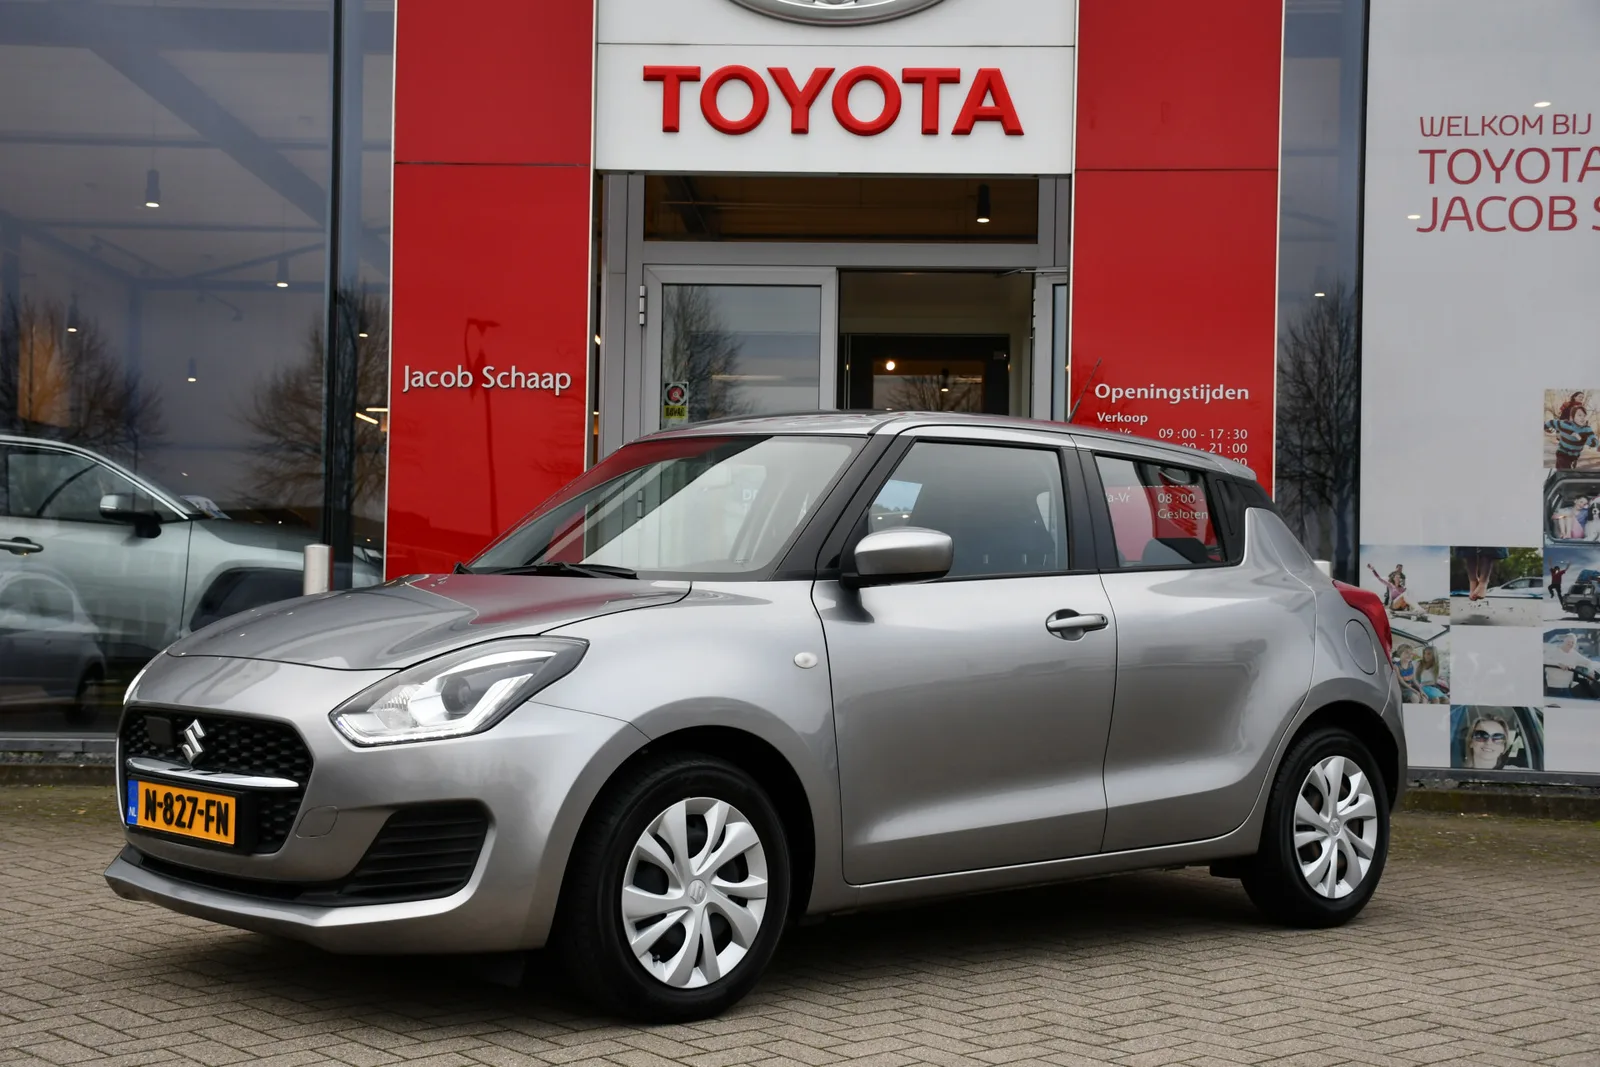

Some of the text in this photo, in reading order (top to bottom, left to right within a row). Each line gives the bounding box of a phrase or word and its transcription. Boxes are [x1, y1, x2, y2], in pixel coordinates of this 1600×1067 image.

[642, 64, 1024, 136] TOYOTA
[1419, 113, 1592, 137] WELKOM BIJ
[1418, 146, 1600, 185] TOYOTA
[1416, 195, 1578, 233] JACOB
[403, 365, 572, 396] Jacob Schaap
[1094, 383, 1250, 404] Openingstijden
[1097, 412, 1149, 425] Verkoop
[1105, 493, 1130, 503] a-Vr
[1157, 508, 1209, 520] Gesloten
[128, 788, 229, 836] NL N-827-FN
